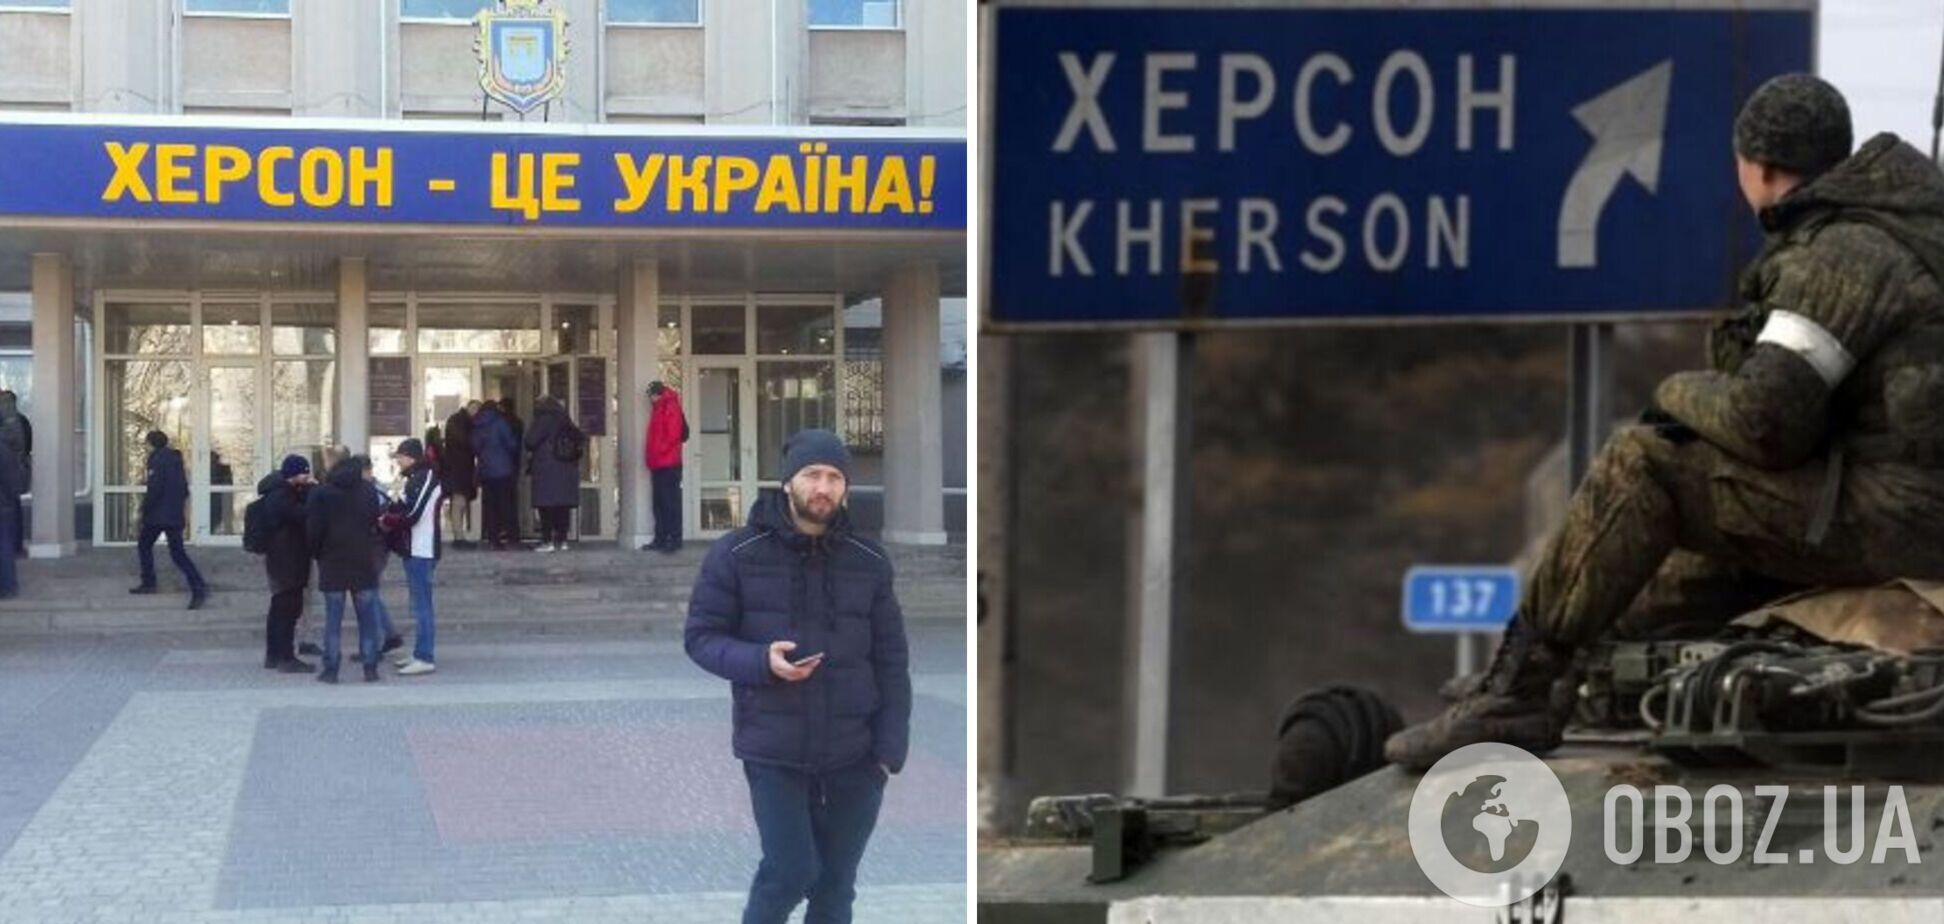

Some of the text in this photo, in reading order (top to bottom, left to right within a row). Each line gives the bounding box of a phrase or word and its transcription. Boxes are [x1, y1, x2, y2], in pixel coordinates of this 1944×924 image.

[1053, 50, 1517, 156] ХЕРСОН
[103, 142, 394, 208] ХЕРСОН
[489, 152, 582, 221] ЦЕ
[614, 141, 937, 215] УКРАЇНА!
[1049, 193, 1473, 276] KHERSON
[1429, 580, 1497, 617] 137
